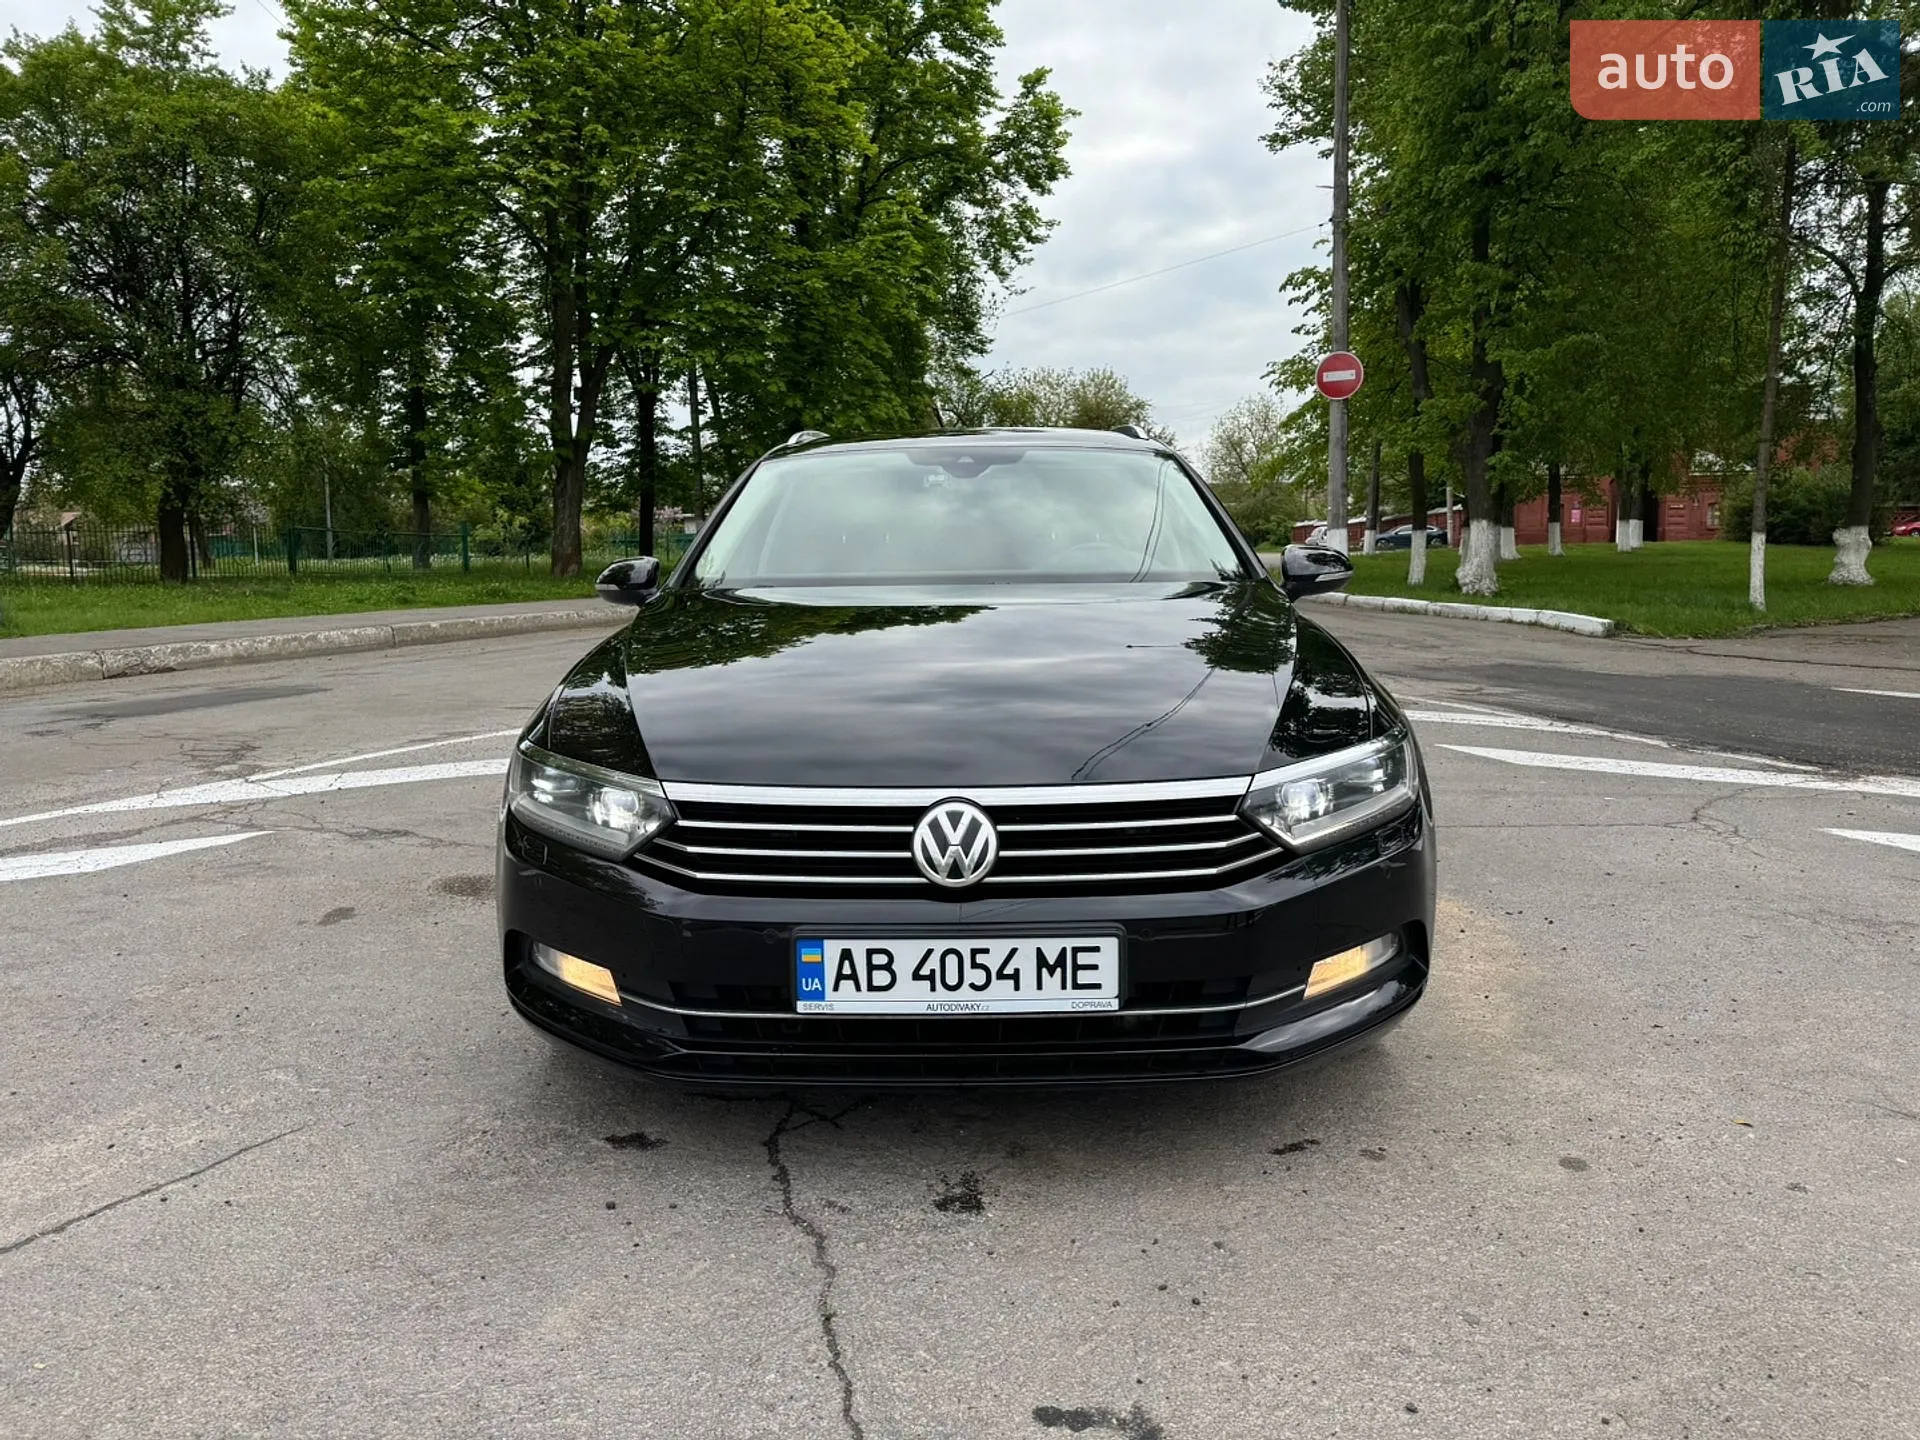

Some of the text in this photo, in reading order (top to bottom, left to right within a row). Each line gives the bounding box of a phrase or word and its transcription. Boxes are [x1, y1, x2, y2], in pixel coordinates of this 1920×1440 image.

[916, 803, 995, 885] VW
[832, 945, 1102, 992] AB 4054 ME
[801, 977, 822, 991] UA
[1071, 1001, 1113, 1009] DOPRAVA
